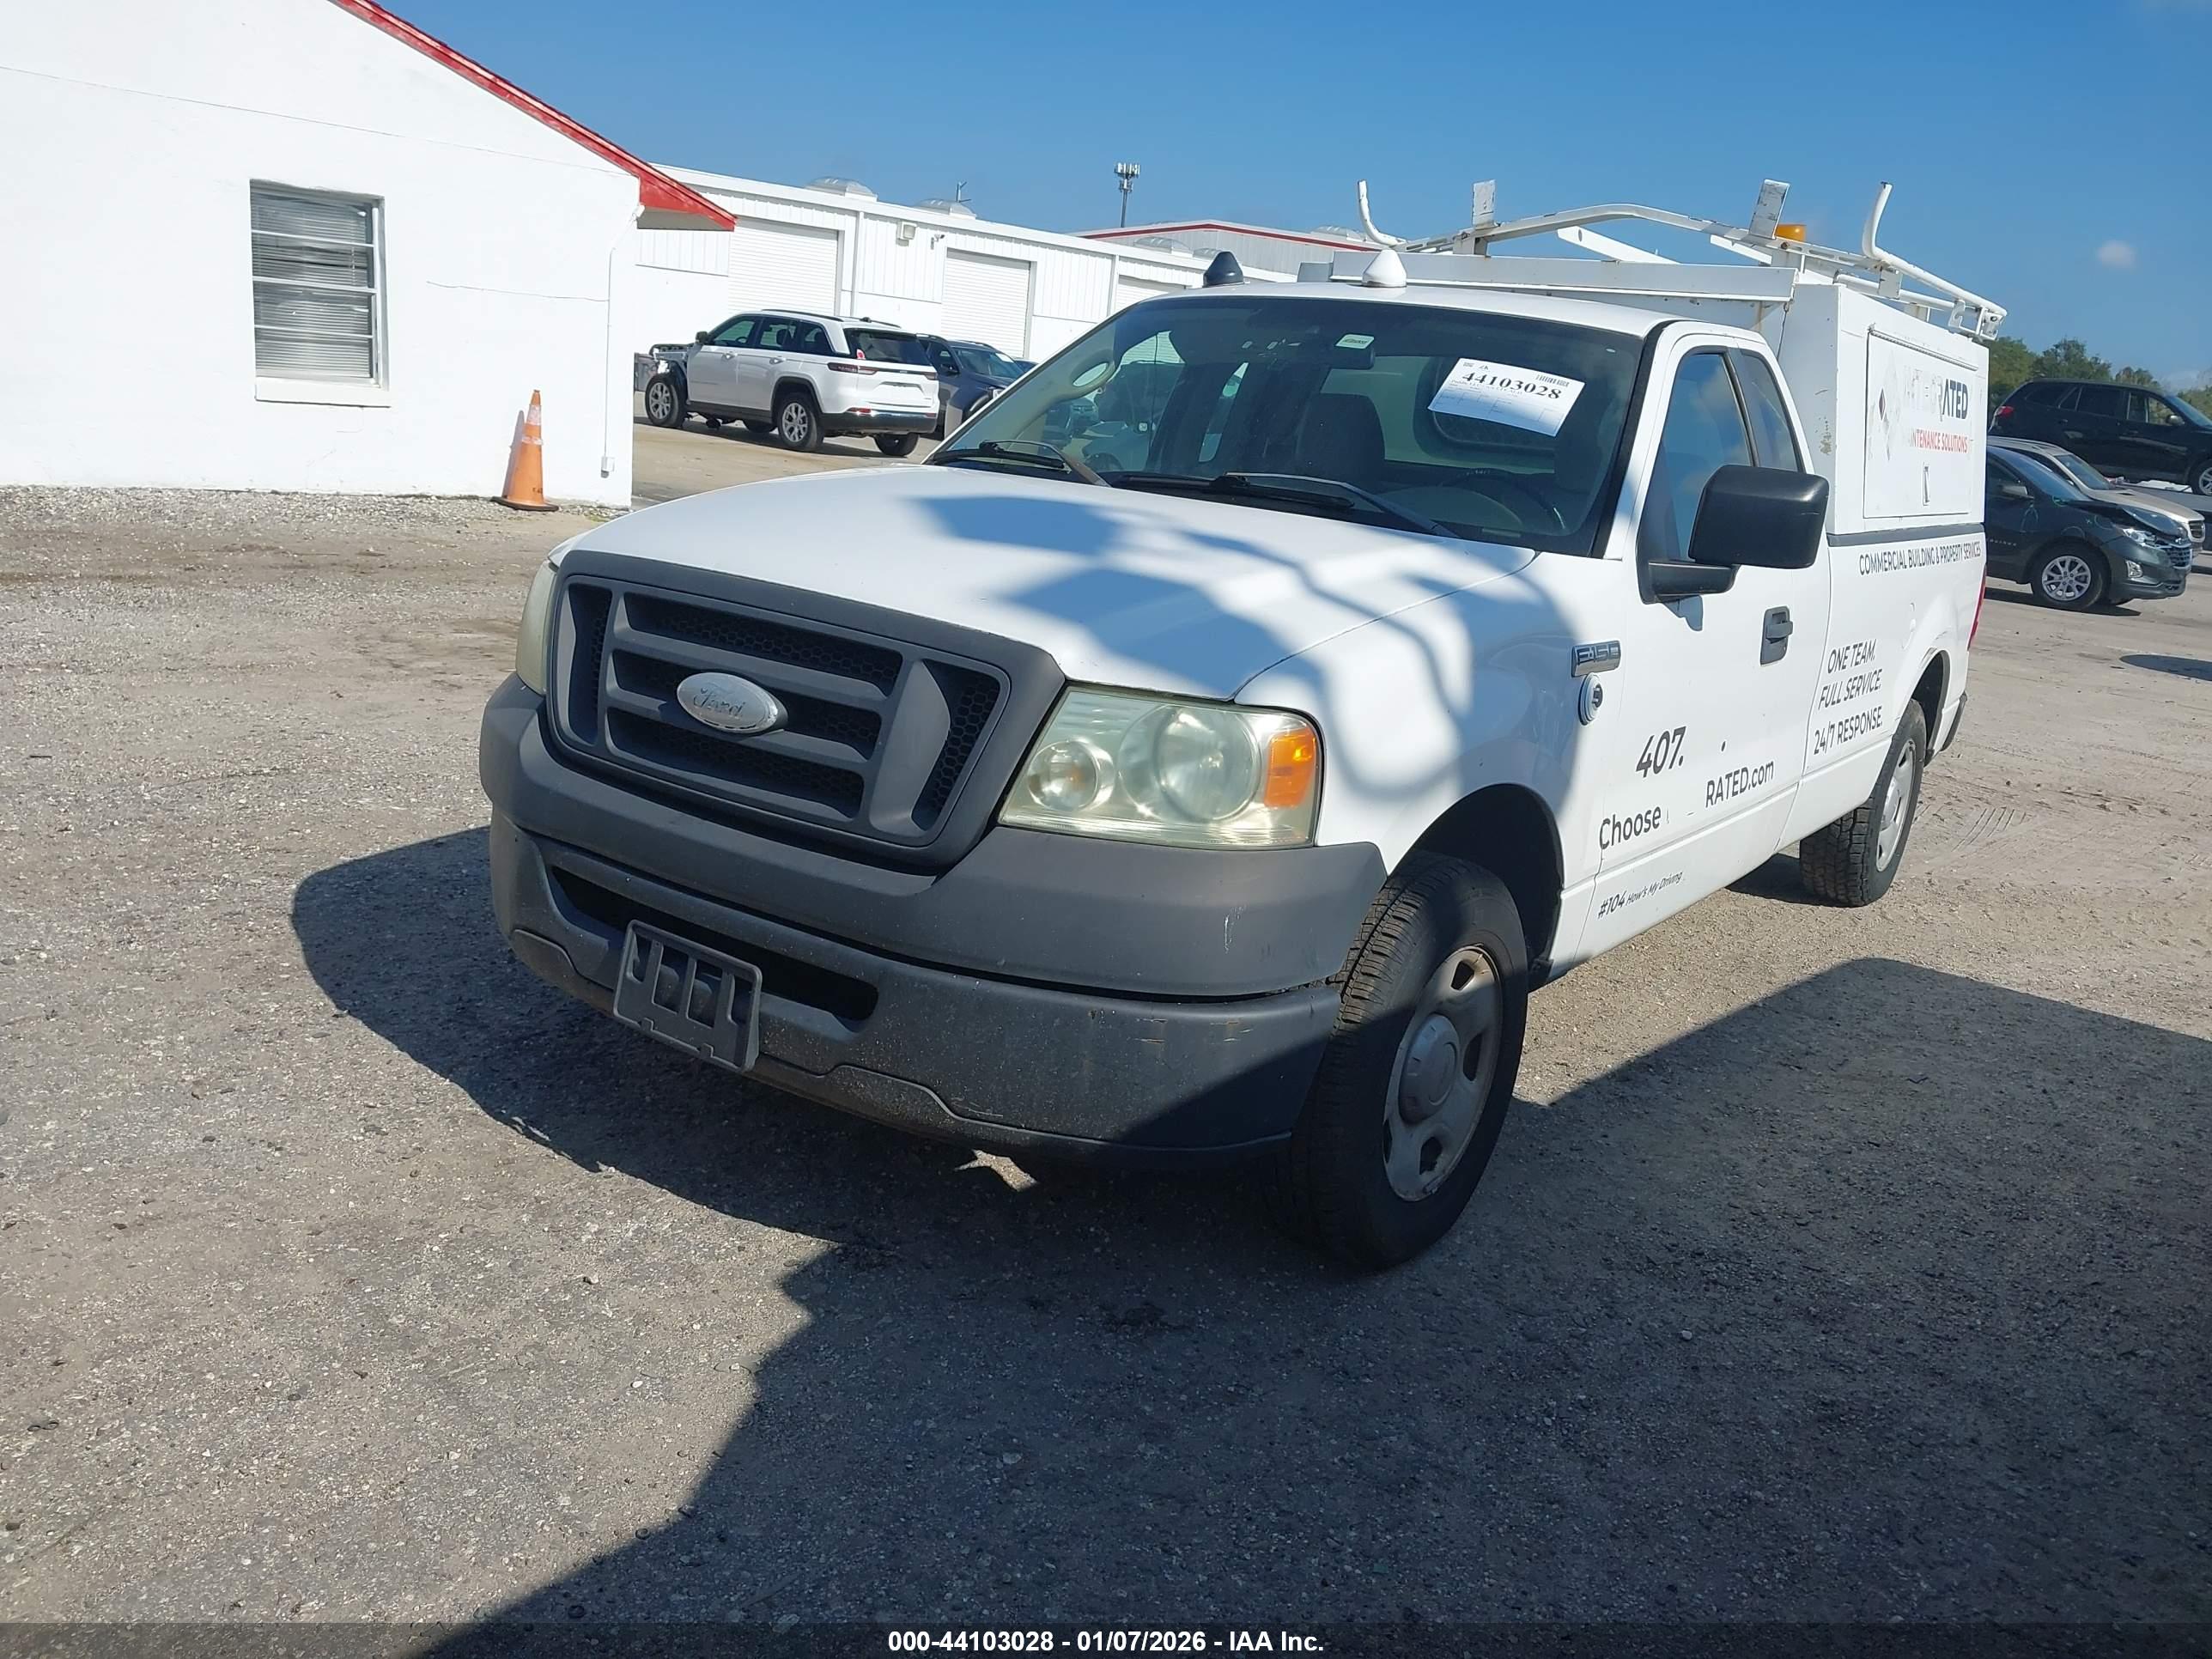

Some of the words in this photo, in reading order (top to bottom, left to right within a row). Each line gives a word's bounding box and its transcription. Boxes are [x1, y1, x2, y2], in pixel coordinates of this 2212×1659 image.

[1462, 371, 1562, 399] 44103028
[1942, 432, 1968, 453] SOLUTIONS
[1859, 550, 1907, 575] COMMERCIAL
[1908, 548, 1936, 568] BUILDING
[1940, 544, 1963, 563] PROPERTY
[1964, 541, 1981, 559] SERVICES
[1827, 646, 1850, 674] ONE
[1818, 681, 1843, 711] FULL
[1813, 721, 1836, 756] 24/7
[1599, 806, 1662, 850] Choose
[1705, 761, 1774, 808] RATED.com
[1597, 890, 1627, 920] #104
[1626, 886, 1648, 907] How's
[1648, 881, 1659, 896] My
[1659, 871, 1683, 890] Driving
